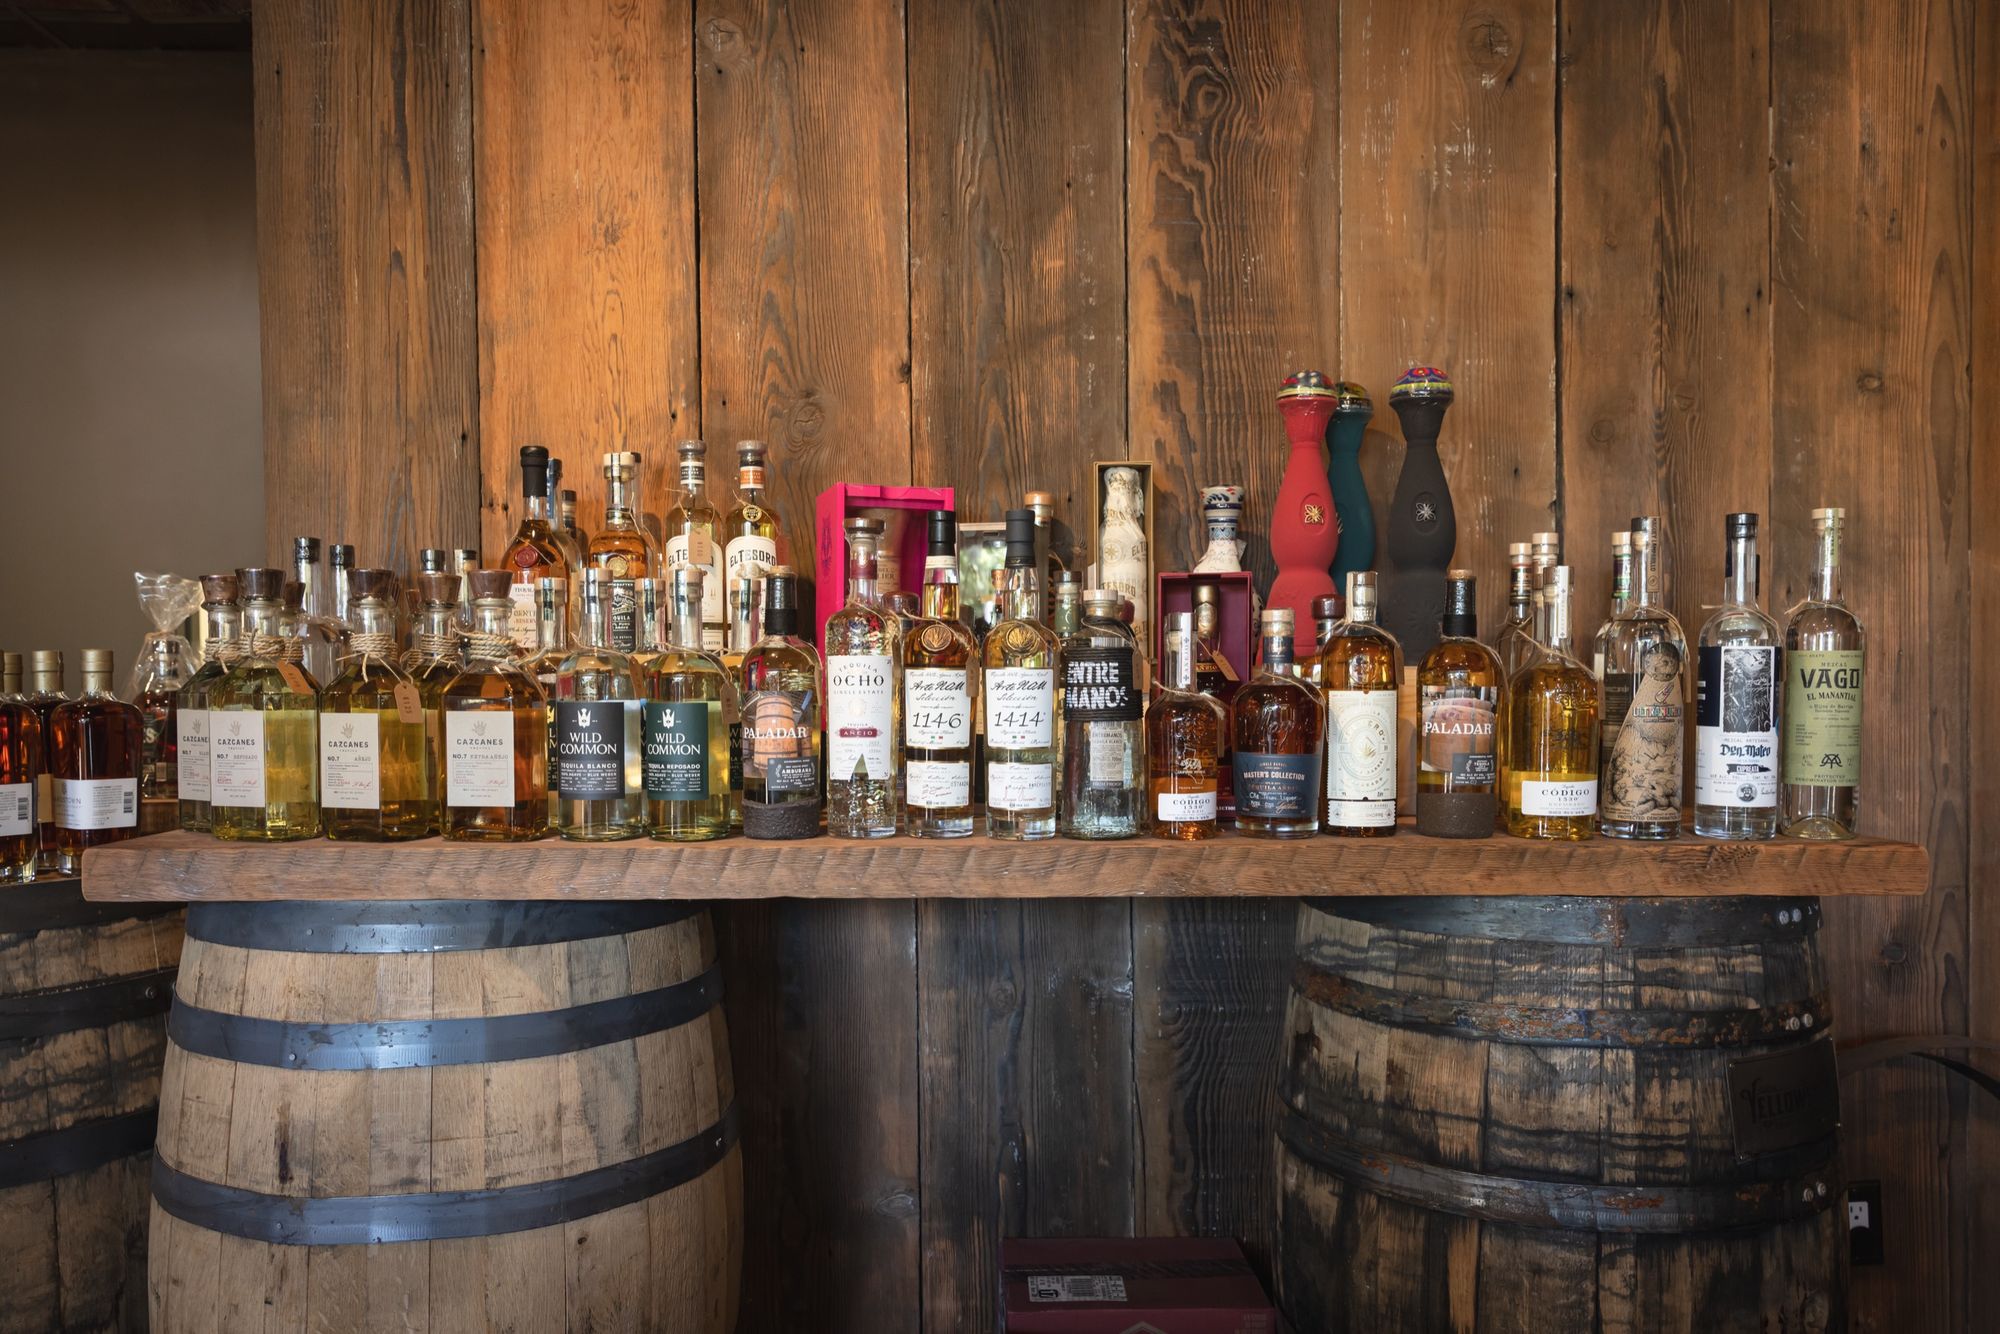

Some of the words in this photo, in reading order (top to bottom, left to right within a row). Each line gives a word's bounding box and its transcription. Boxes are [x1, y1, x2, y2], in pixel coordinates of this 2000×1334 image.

[738, 549, 776, 567] TESORO
[839, 663, 878, 673] TEQUILA
[1067, 661, 1119, 684] ENTRE
[833, 674, 884, 687] OCHO
[1800, 668, 1860, 688] VAGO
[1066, 686, 1128, 709] MANOS
[1807, 693, 1816, 701] EL
[1819, 691, 1856, 702] MANANTIAL
[912, 712, 961, 729] 1146
[994, 711, 1045, 728] 1414
[744, 727, 807, 739] PALADAR
[1425, 721, 1492, 735] PALADAR
[182, 735, 209, 743] CAZCANE
[569, 732, 602, 743] WILD
[655, 732, 685, 743] WILD
[560, 743, 617, 755] COMMON
[647, 743, 701, 755] COMMON
[1720, 744, 1744, 757] Don
[1744, 744, 1771, 757] Mateo
[1243, 771, 1269, 779] MASTER'S
[1270, 771, 1305, 780] COLLECTION
[1541, 788, 1590, 796] CÓDIGO
